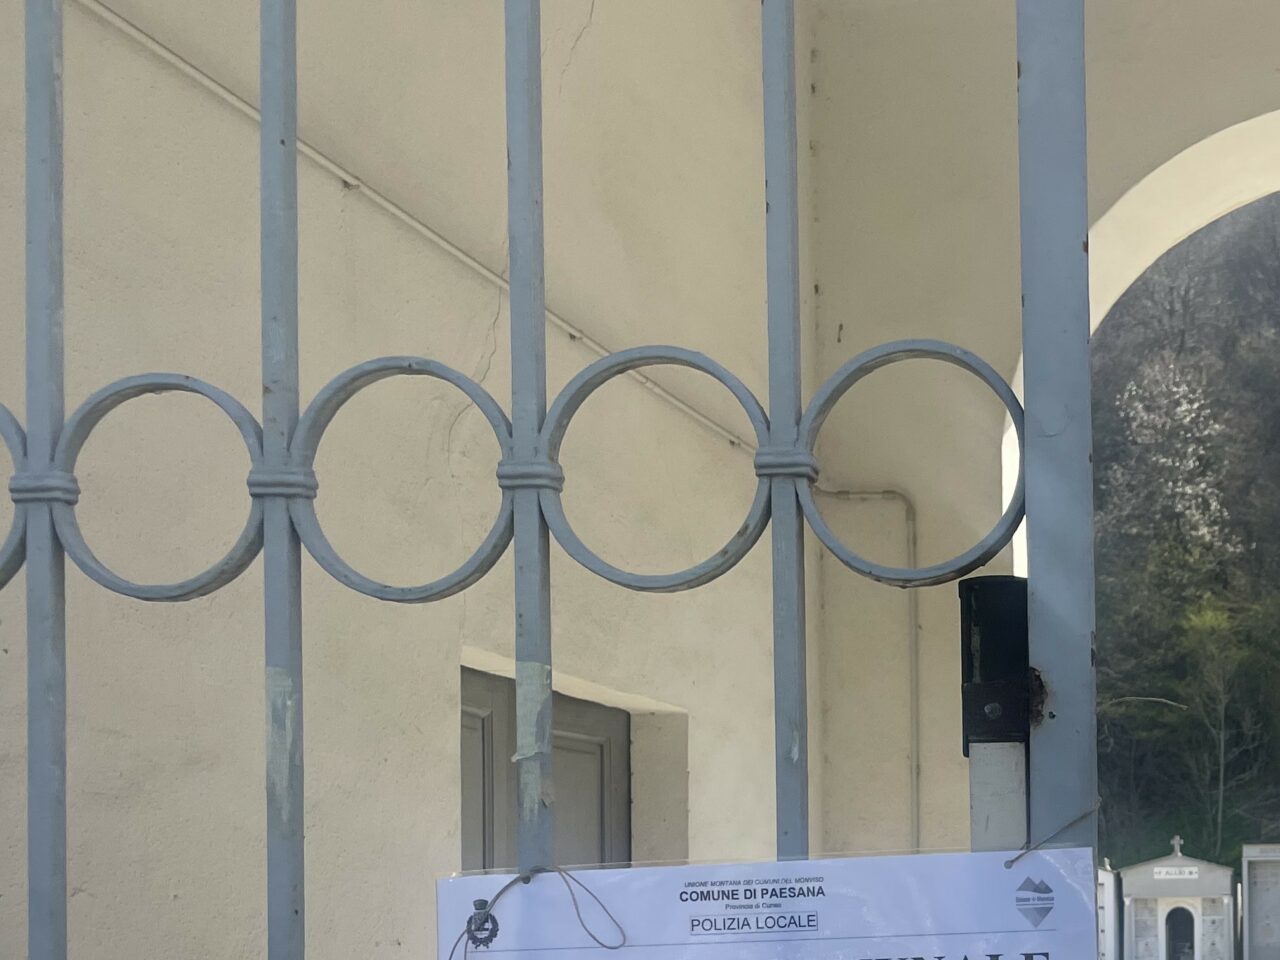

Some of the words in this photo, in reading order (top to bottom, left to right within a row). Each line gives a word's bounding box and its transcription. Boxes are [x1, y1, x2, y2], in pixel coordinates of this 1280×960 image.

[678, 889, 742, 903] COMUNE
[744, 888, 757, 901] DI
[759, 885, 826, 900] PAESANA
[691, 915, 750, 932] POLIZIA
[755, 913, 817, 929] LOCALE
